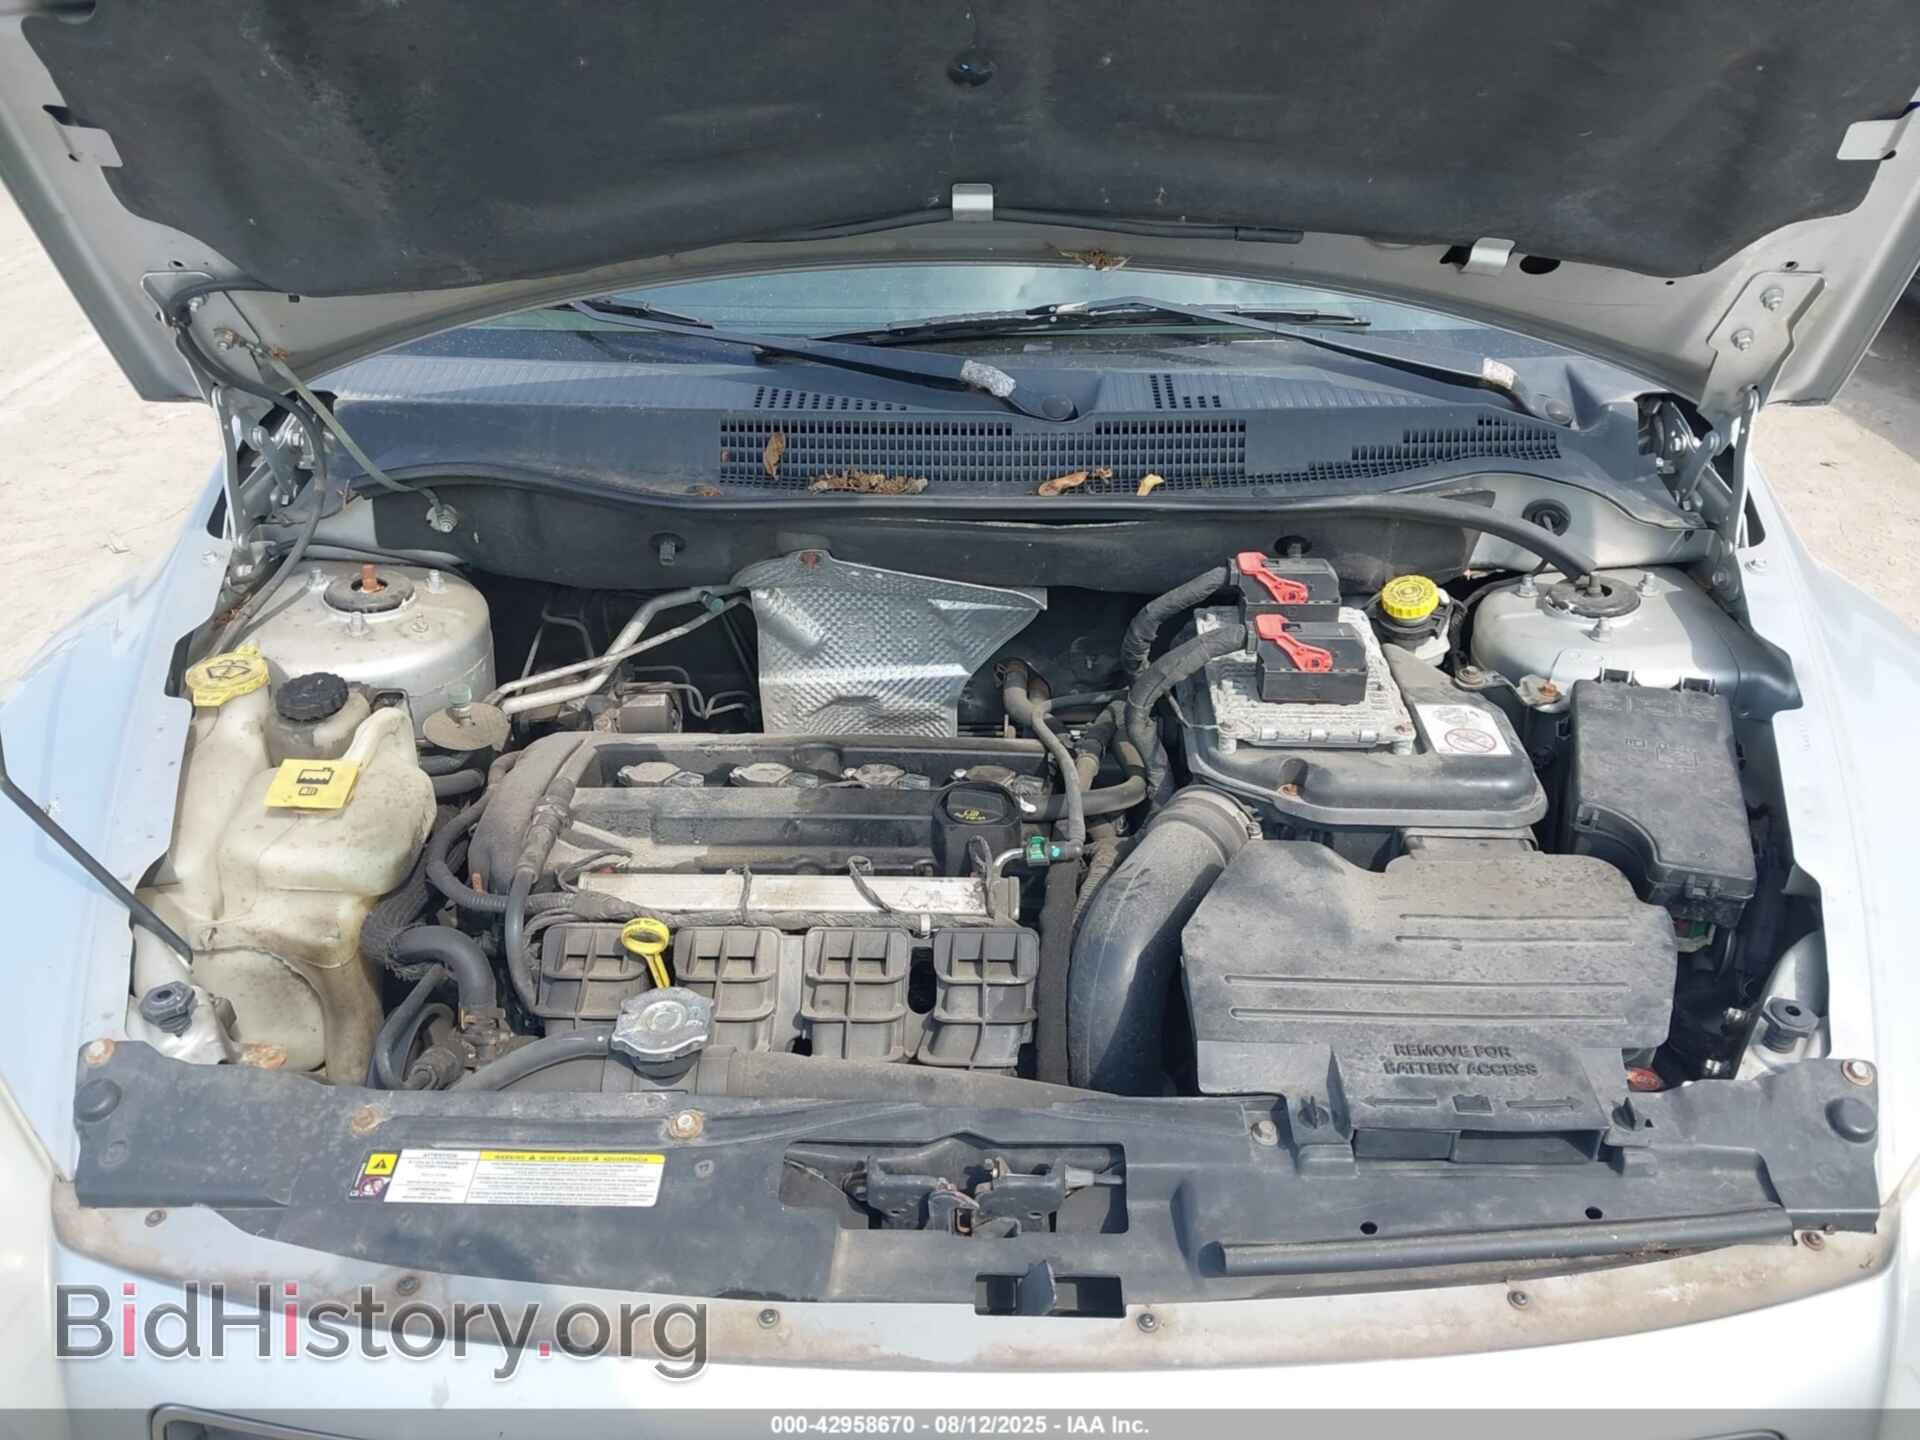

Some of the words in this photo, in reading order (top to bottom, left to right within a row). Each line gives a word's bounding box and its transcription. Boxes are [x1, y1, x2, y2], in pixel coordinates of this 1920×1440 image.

[1393, 1043, 1473, 1058] REMOVE
[1473, 1045, 1512, 1059] FOR
[1383, 1061, 1460, 1075] BATTERY
[1466, 1062, 1539, 1076] ACCESS
